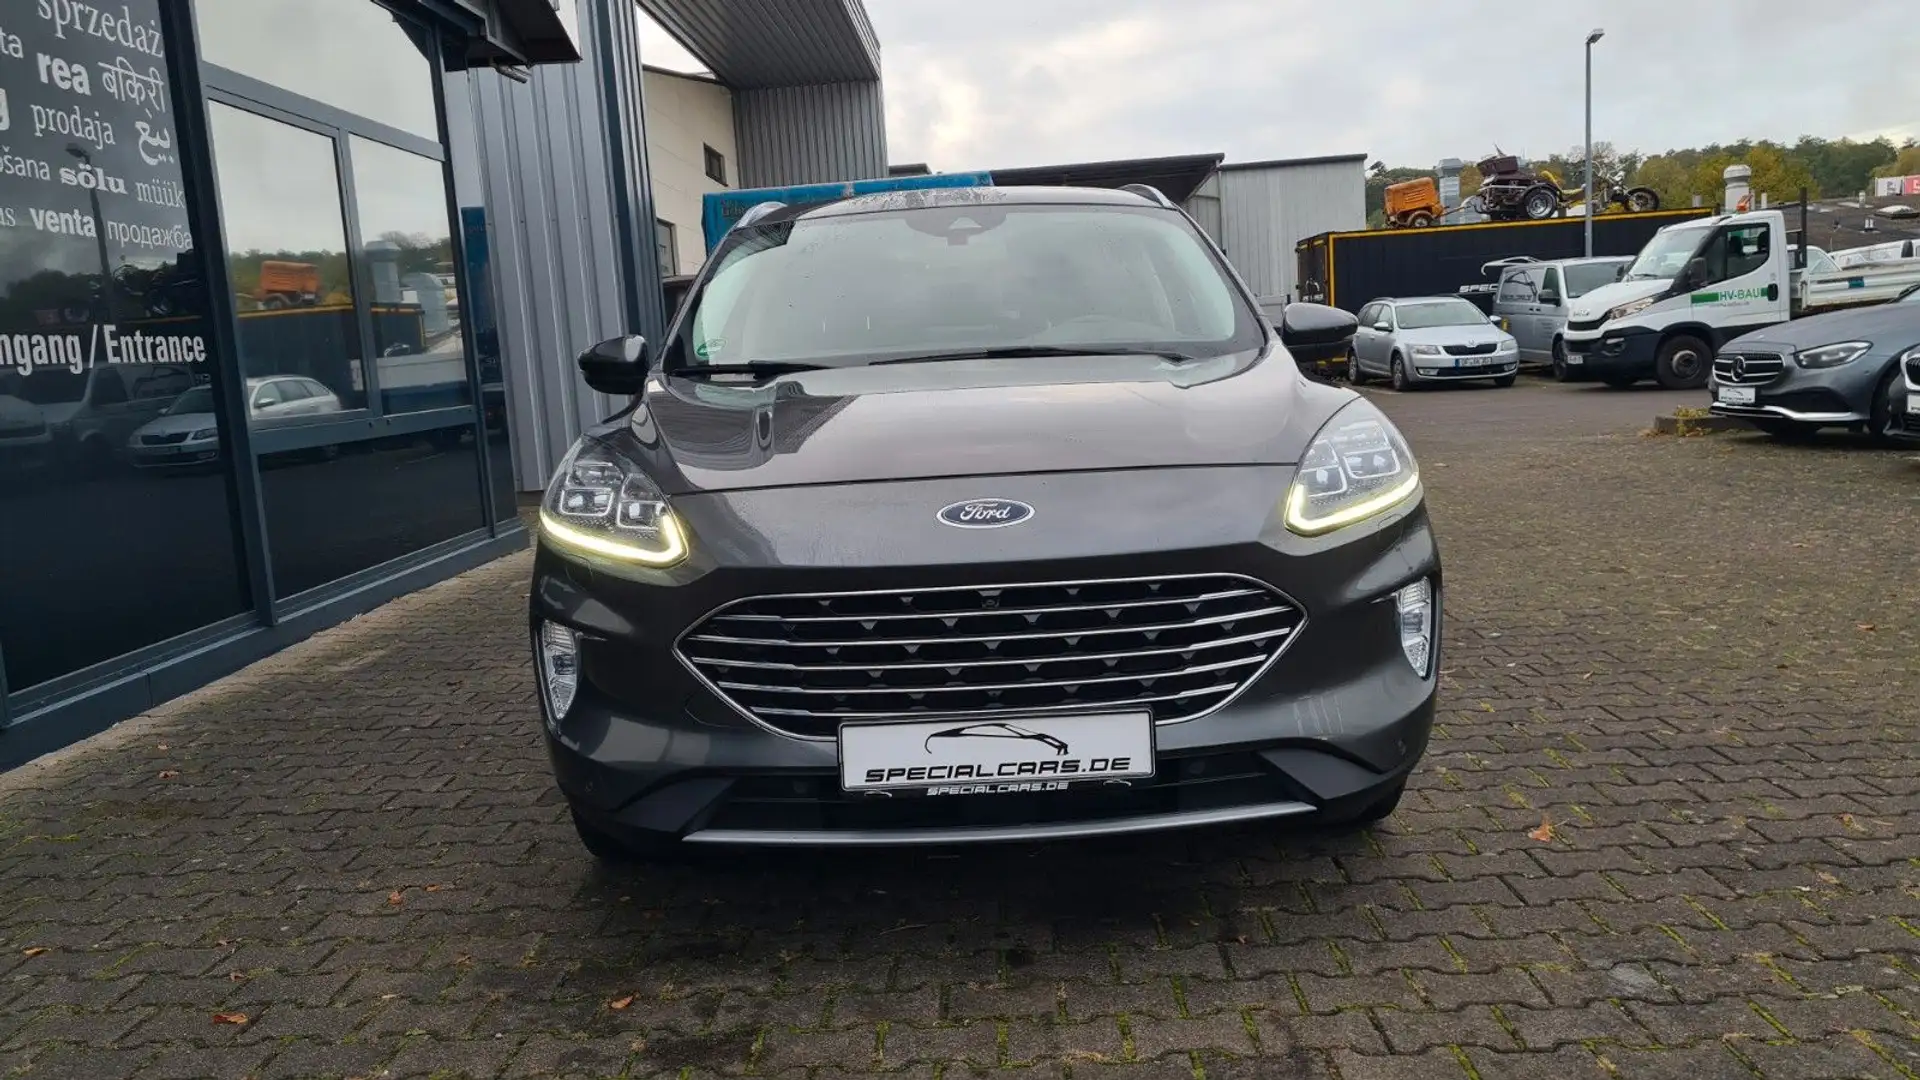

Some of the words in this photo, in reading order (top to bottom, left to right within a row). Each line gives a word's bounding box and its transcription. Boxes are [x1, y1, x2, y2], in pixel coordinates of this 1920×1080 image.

[38, 0, 164, 57] sprzedaż
[37, 52, 91, 96] rea
[31, 104, 116, 150] prodaja
[59, 164, 128, 195] sölu
[135, 178, 185, 209] müük
[29, 207, 97, 238] venta
[107, 220, 194, 250] продажба
[103, 324, 207, 365] Entrance
[959, 502, 1012, 521] Ford
[865, 757, 1131, 784] SPECIALCARS.DE
[926, 781, 1069, 797] SPECIALCARS.DE
